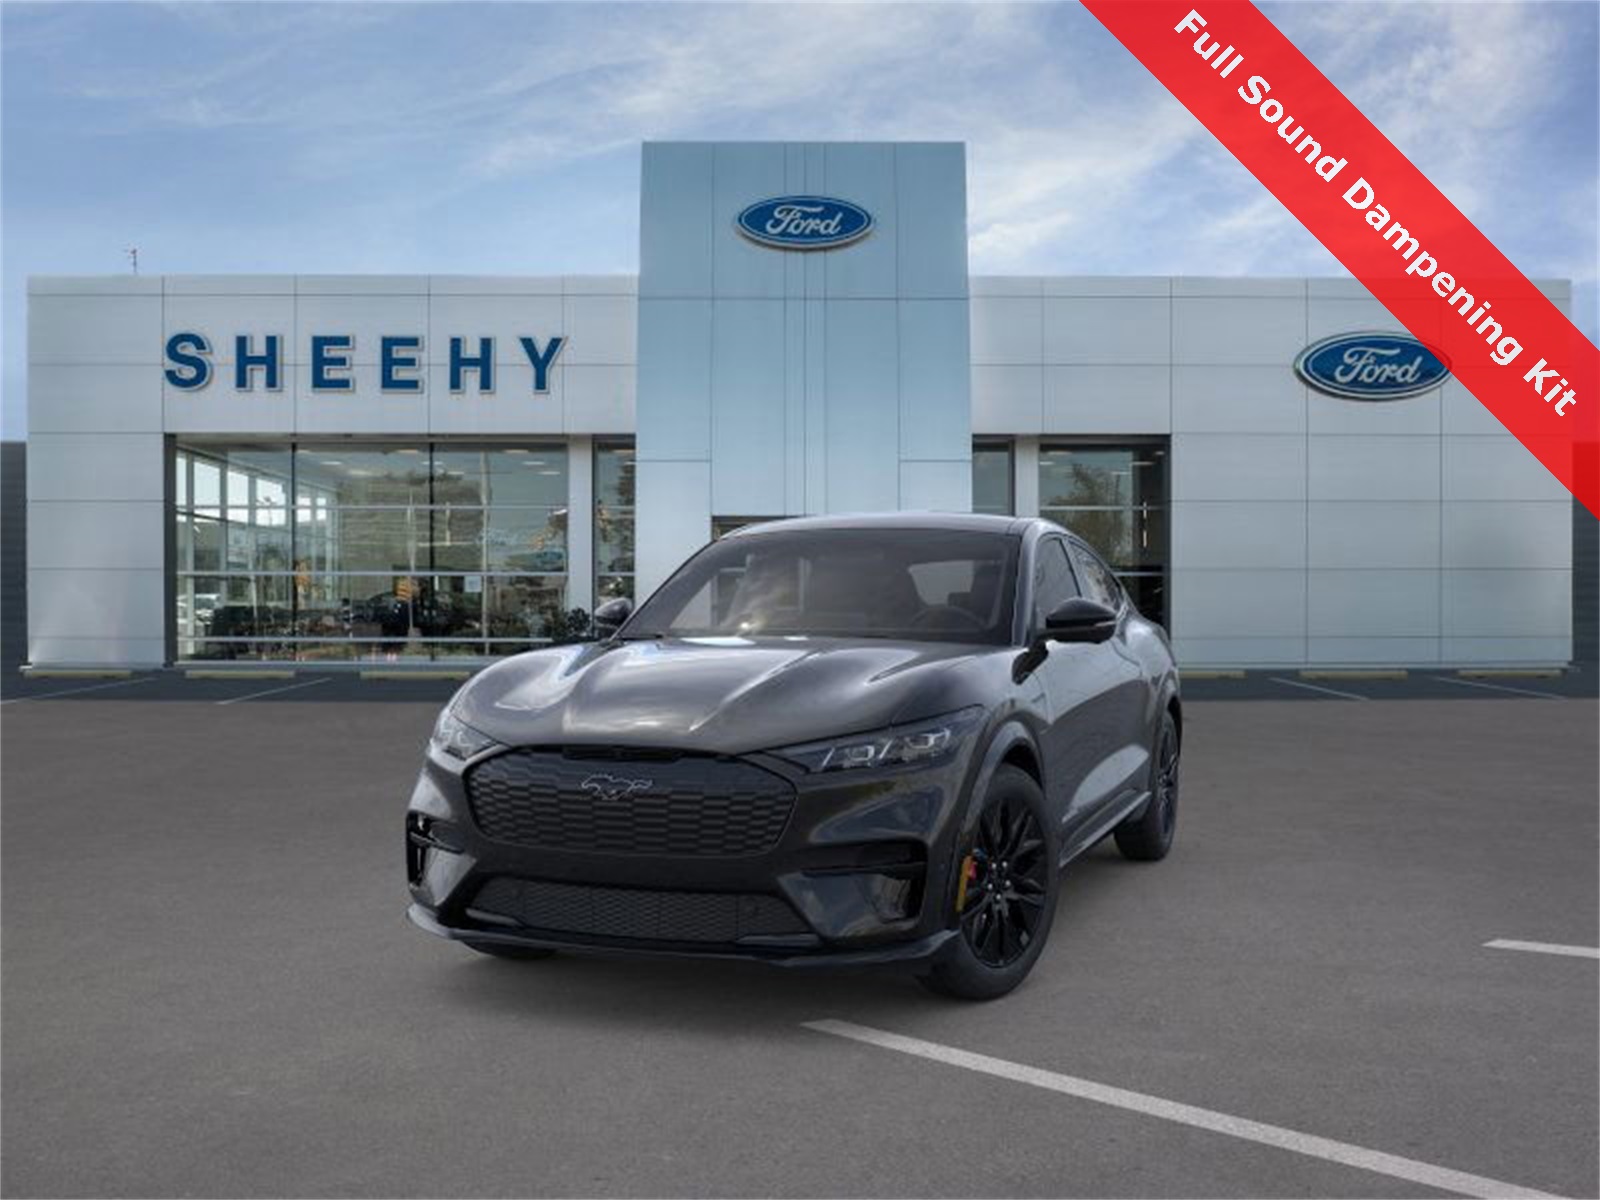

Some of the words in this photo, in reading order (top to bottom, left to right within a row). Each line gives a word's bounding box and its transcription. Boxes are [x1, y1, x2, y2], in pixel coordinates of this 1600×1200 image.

[766, 204, 843, 235] Ford
[164, 333, 566, 393] SHEEHY
[1334, 347, 1421, 385] Ford
